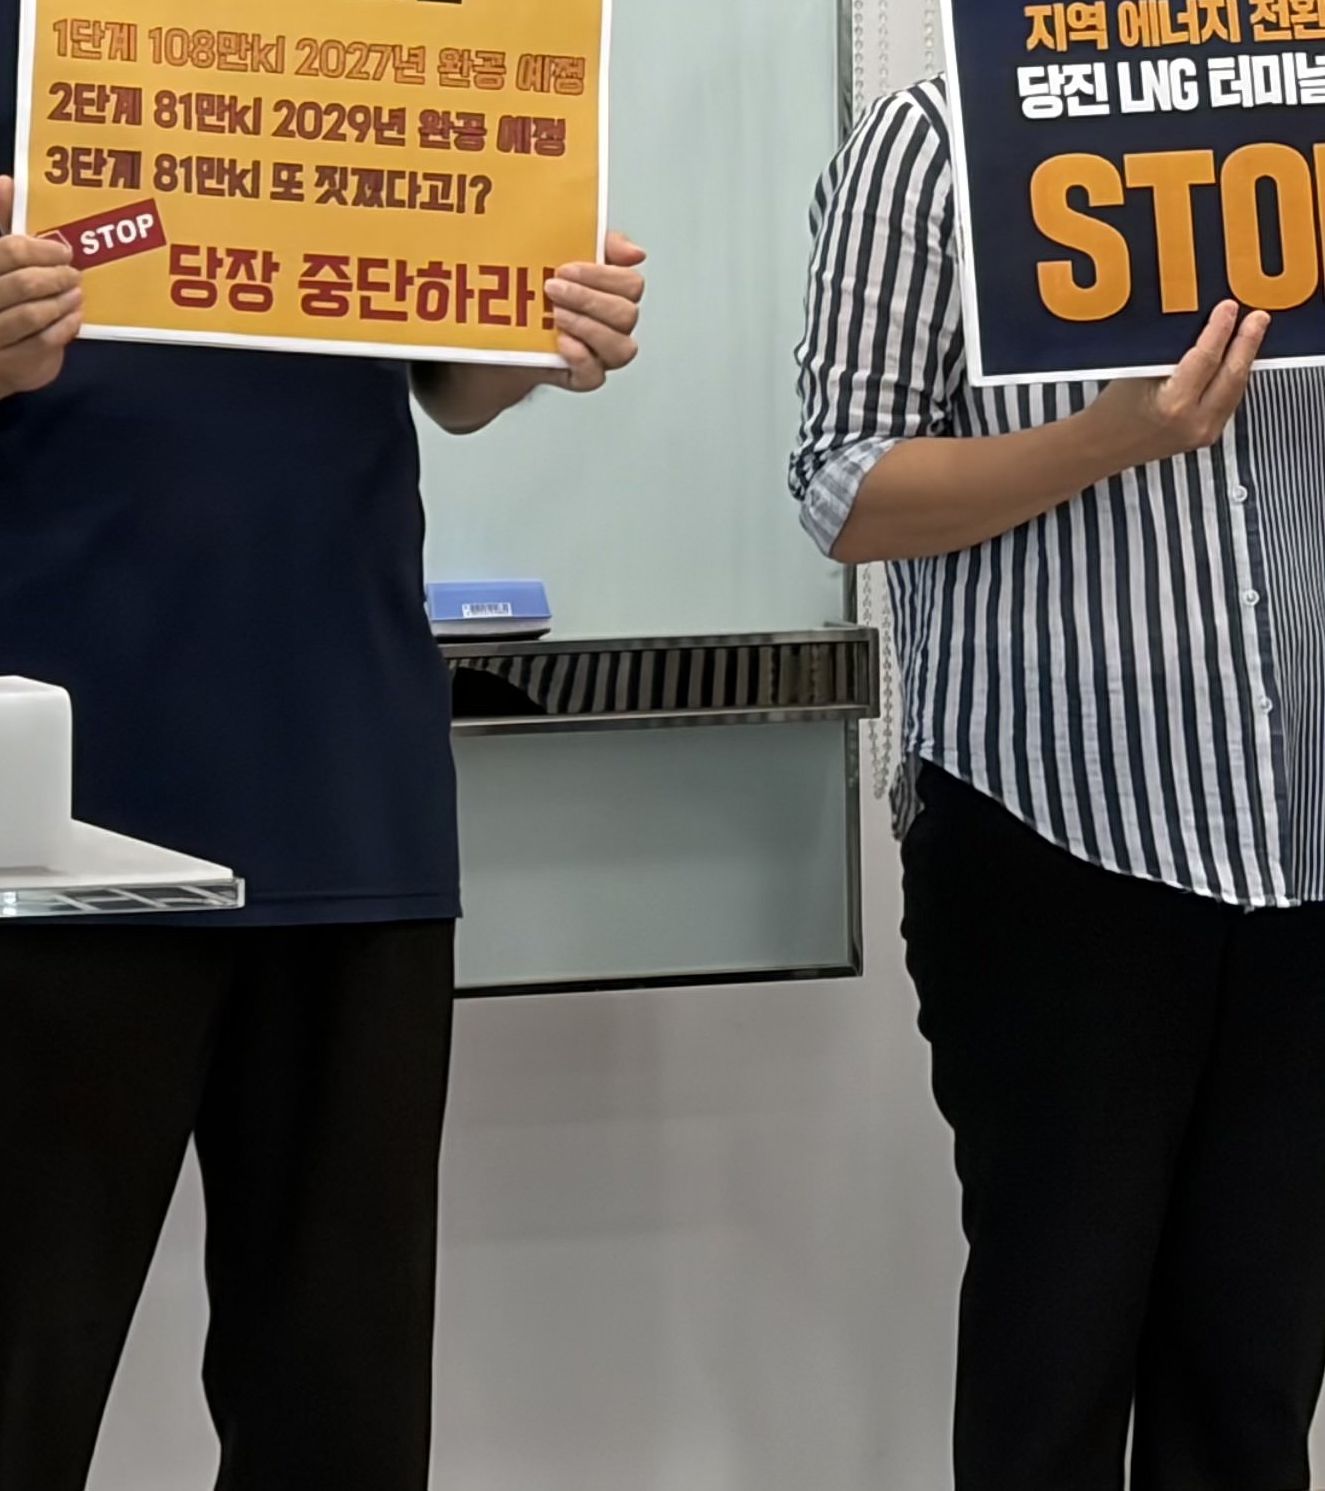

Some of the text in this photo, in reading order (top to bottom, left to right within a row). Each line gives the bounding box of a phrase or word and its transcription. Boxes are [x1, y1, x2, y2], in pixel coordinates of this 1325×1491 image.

[52, 18, 138, 62] 1단계
[294, 38, 426, 86] 2027년
[437, 47, 506, 91] 완공
[516, 53, 586, 96] 예정
[1024, 0, 1108, 52] 지역
[46, 81, 143, 126] 2단계
[271, 98, 407, 147] 2029년
[418, 108, 487, 152] 완공
[496, 115, 566, 157] 예정
[1016, 61, 1110, 120] 당진
[1117, 58, 1198, 114] LNG
[44, 145, 142, 190] 3단계
[270, 162, 305, 202] 또
[79, 213, 154, 256] STOP
[1029, 142, 1325, 322] STO
[168, 243, 280, 313] 당장
